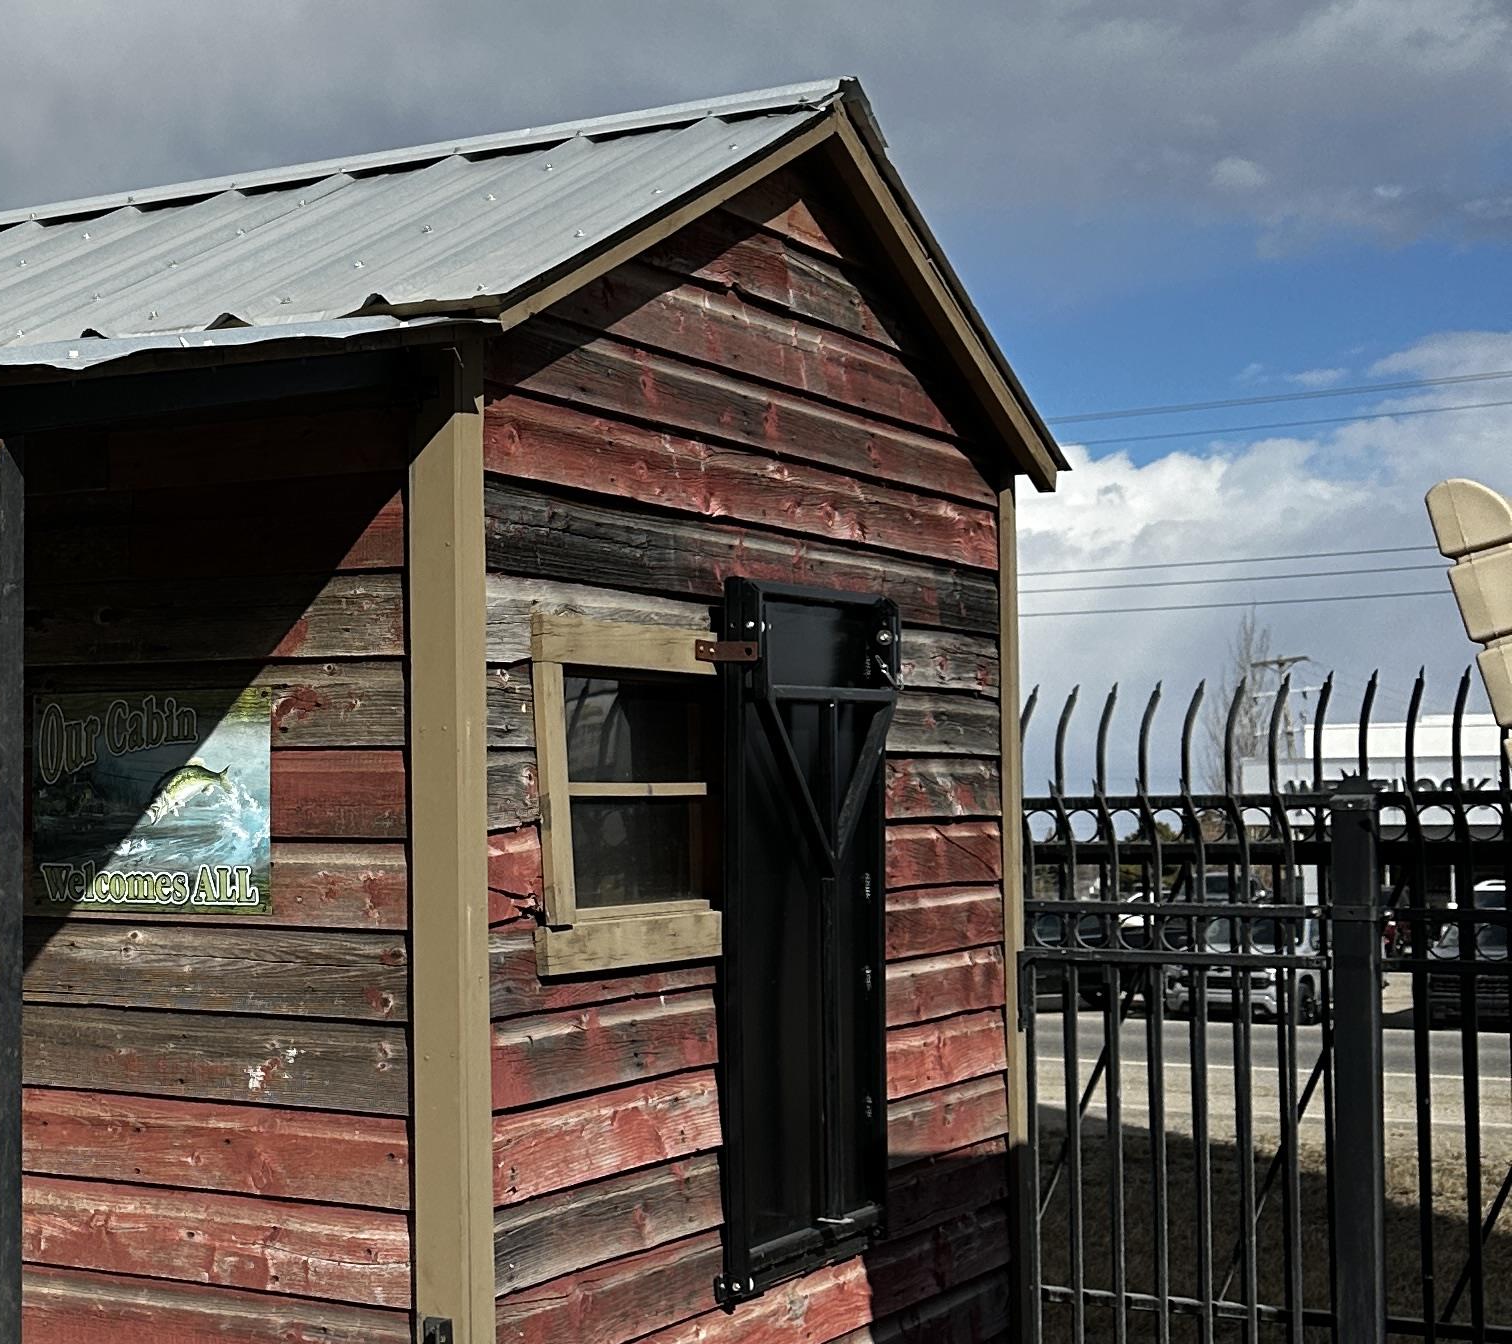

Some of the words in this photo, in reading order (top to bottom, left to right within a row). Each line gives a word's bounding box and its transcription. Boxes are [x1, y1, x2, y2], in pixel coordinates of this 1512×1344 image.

[39, 703, 101, 784] Our
[105, 694, 199, 756] Cabin
[40, 860, 190, 904] Welcomes
[191, 863, 260, 905] ALL
